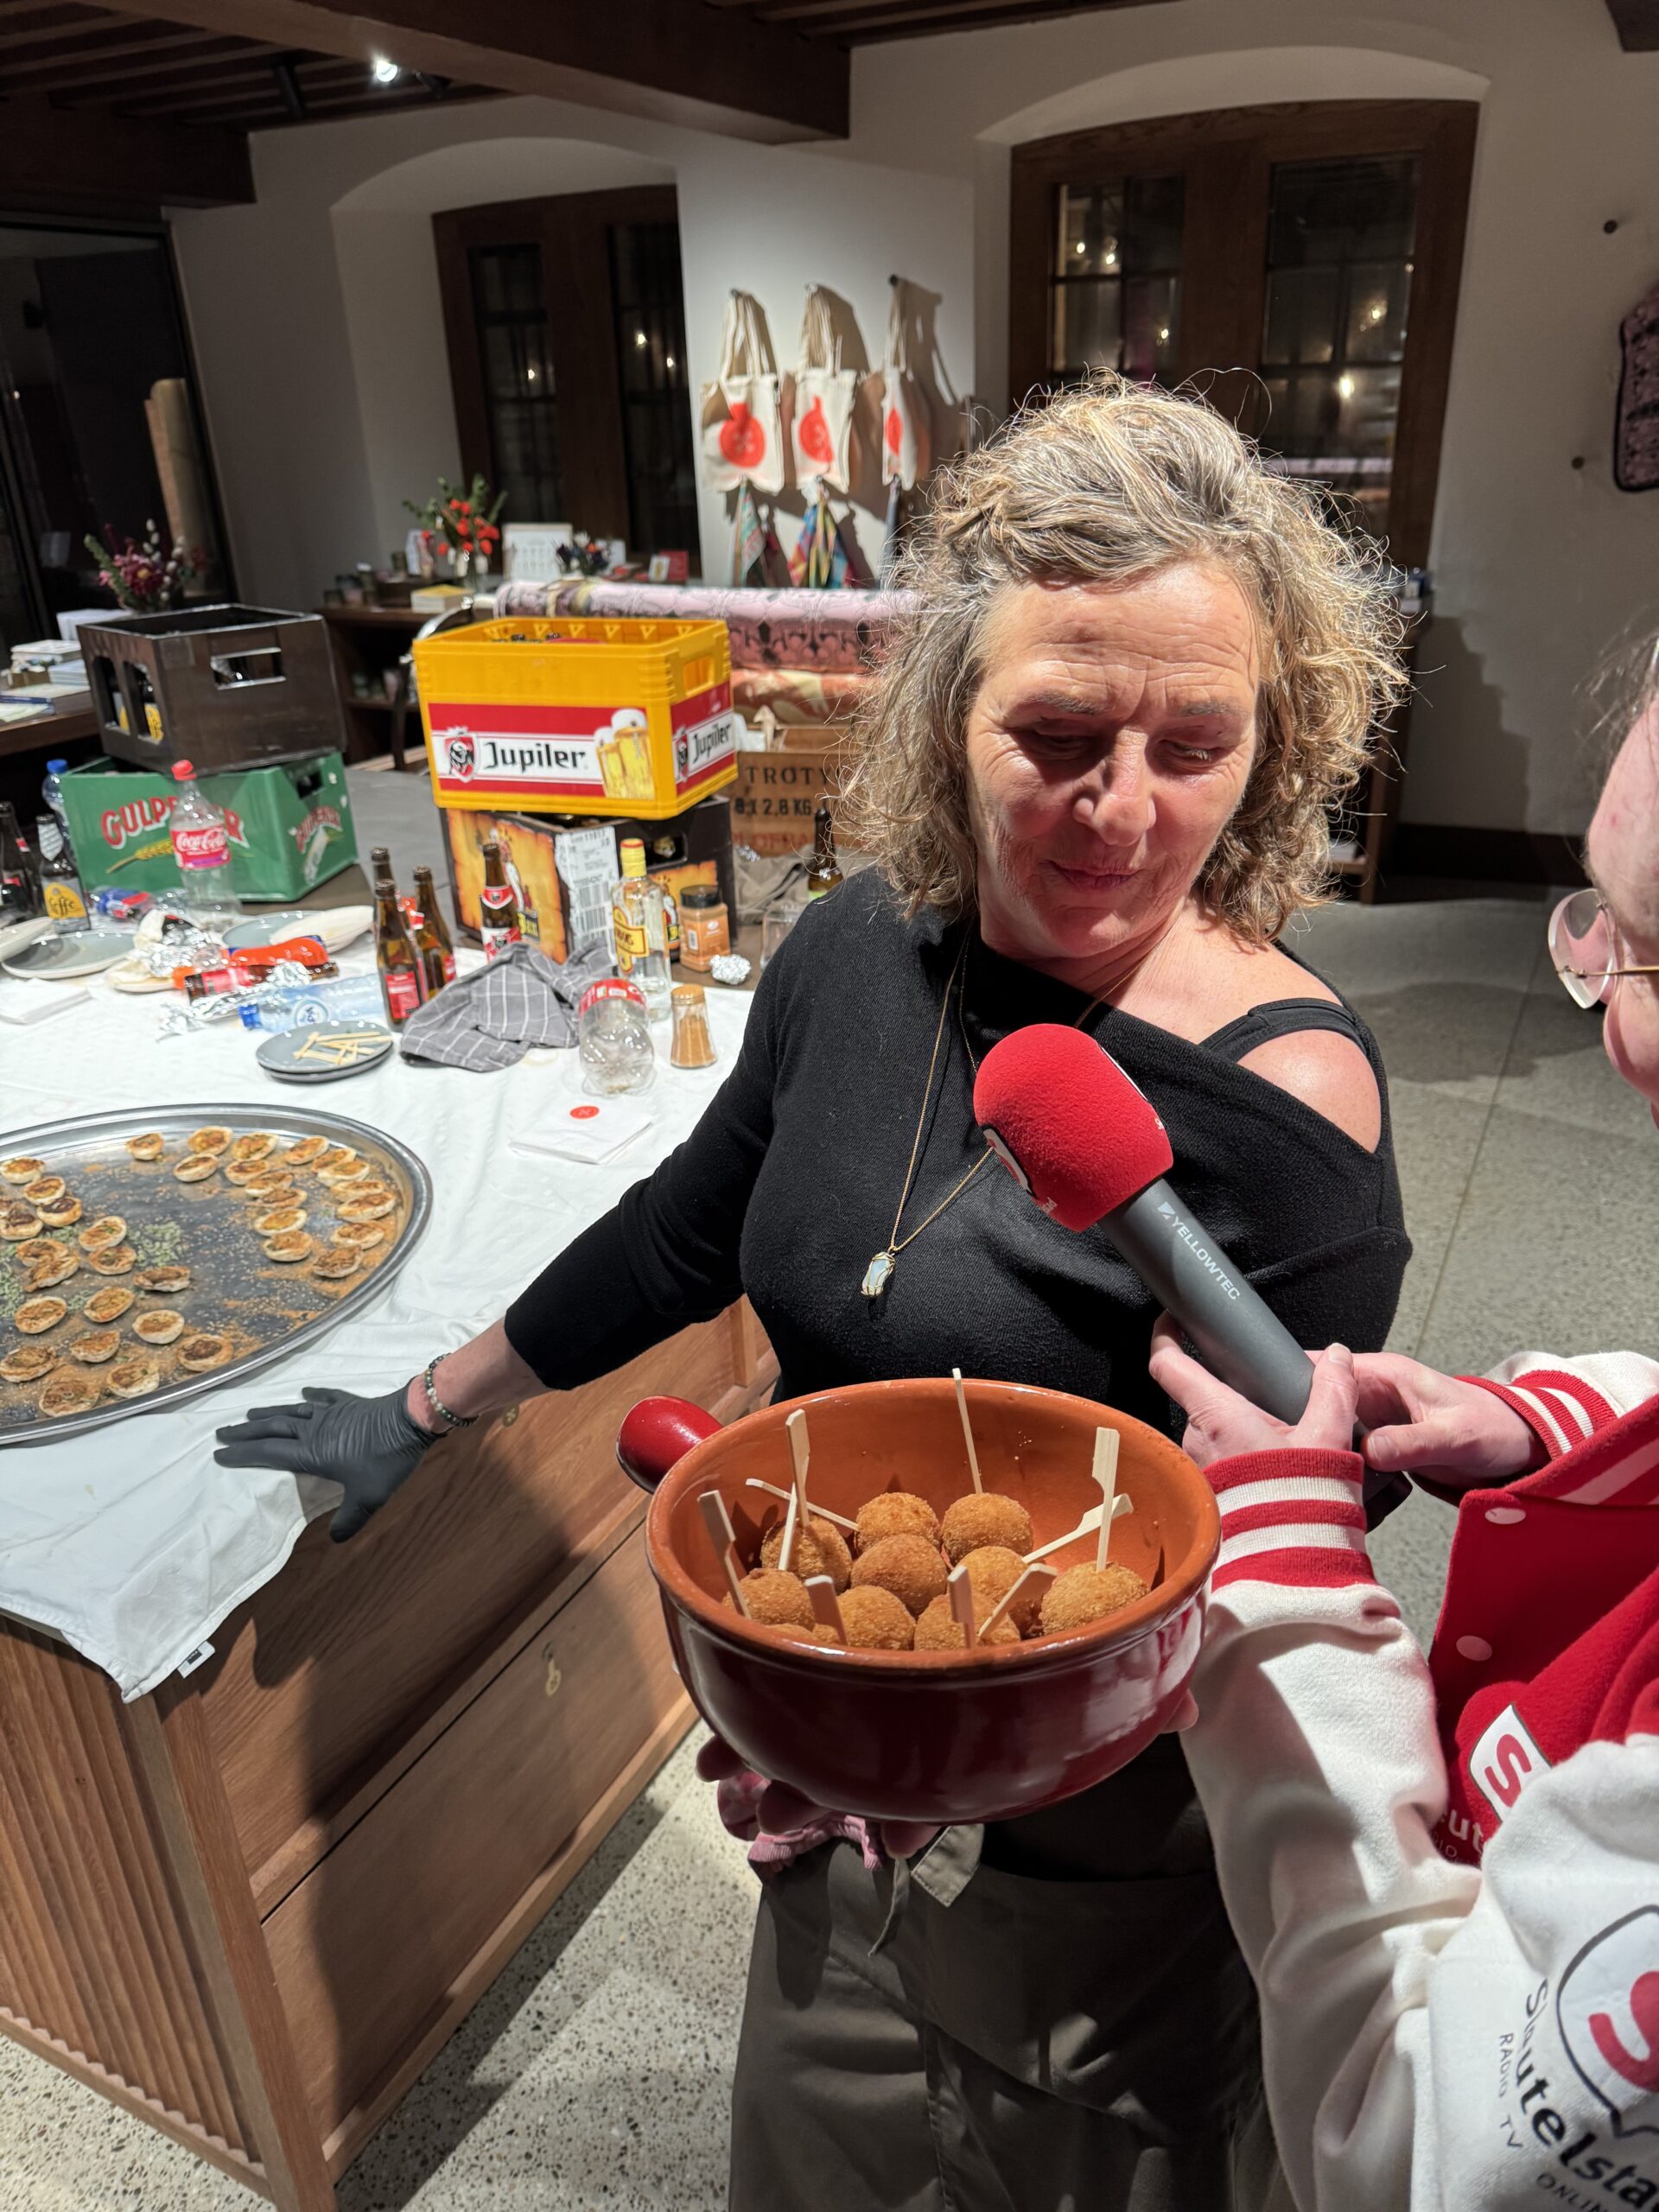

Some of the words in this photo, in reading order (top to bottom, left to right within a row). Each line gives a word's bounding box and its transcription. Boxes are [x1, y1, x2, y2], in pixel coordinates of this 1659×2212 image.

[483, 741, 586, 773] Jupiler
[746, 766, 842, 785] TROTY
[1172, 1216, 1240, 1300] YELLOWTEC
[1498, 2032, 1514, 2099] RADIO
[1516, 1978, 1659, 2212] Sleutelsta
[1499, 2113, 1524, 2149] TV
